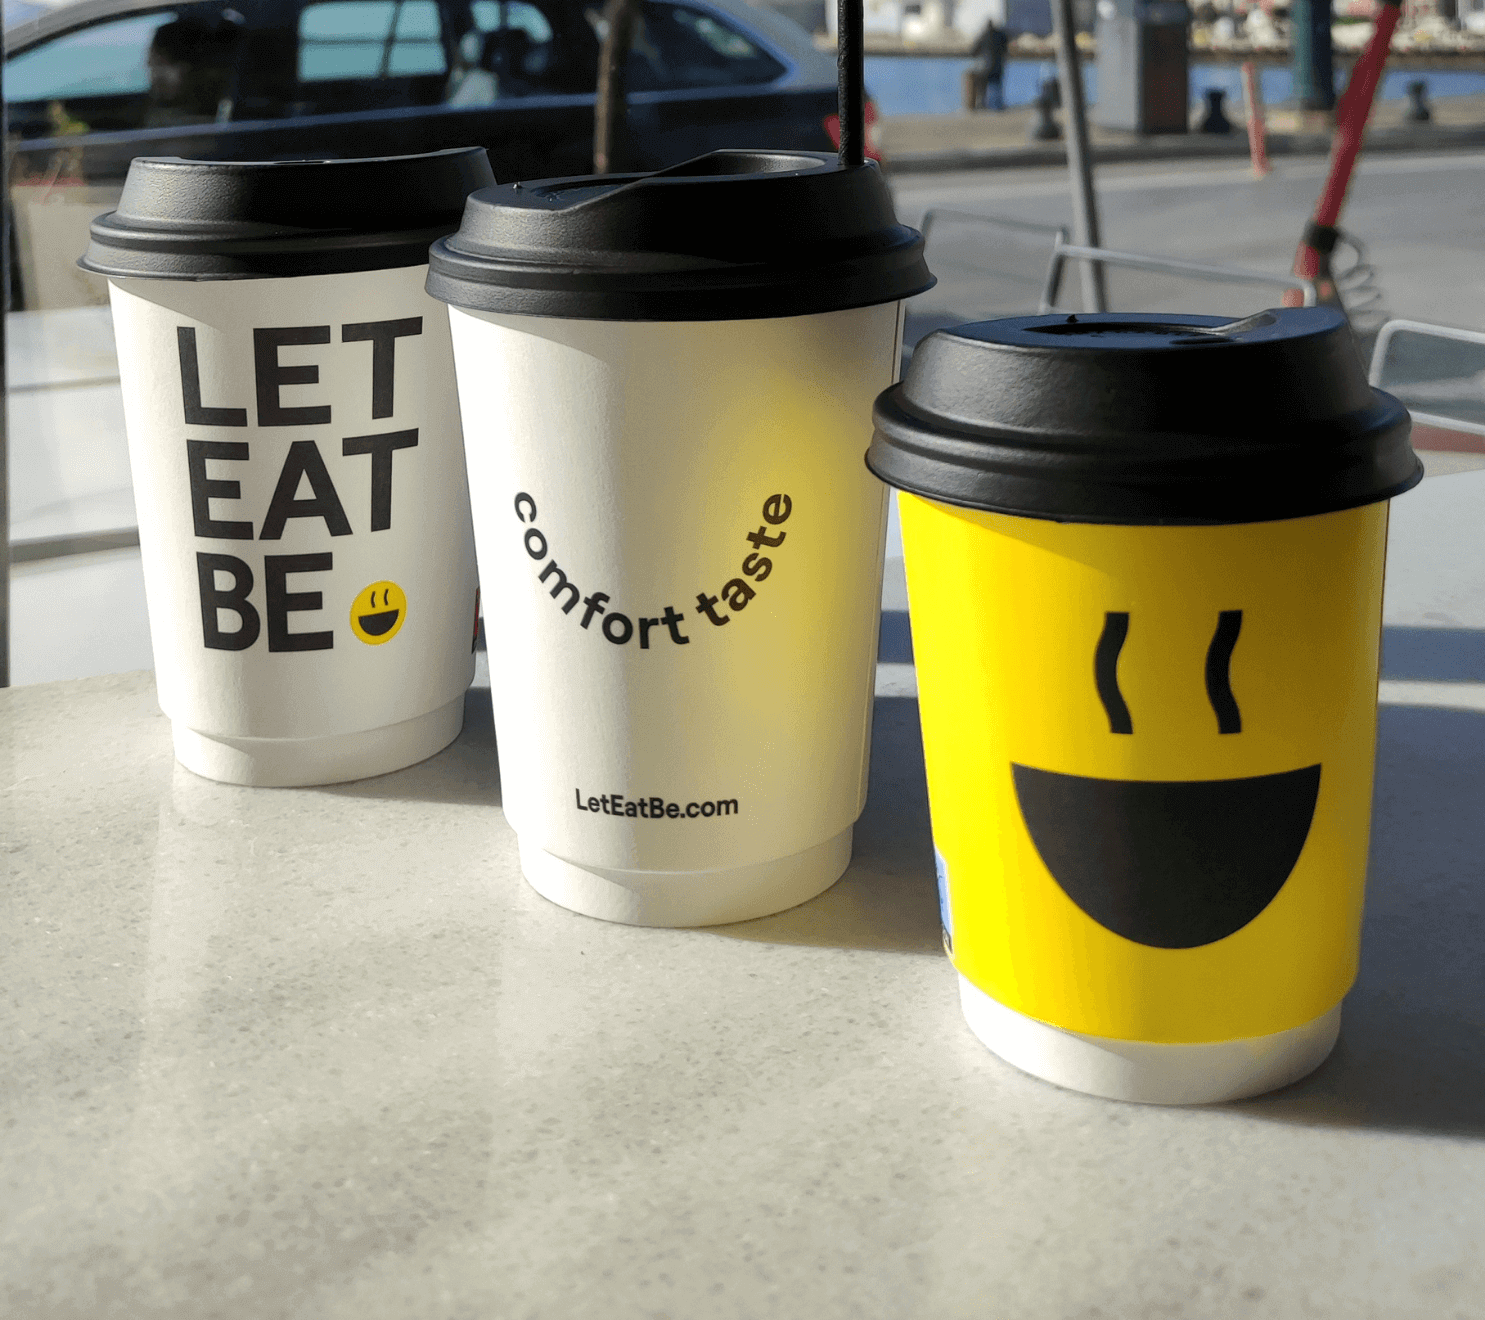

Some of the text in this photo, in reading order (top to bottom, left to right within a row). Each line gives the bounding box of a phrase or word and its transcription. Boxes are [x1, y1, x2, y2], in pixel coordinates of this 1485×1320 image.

[176, 315, 424, 428] LET
[186, 427, 420, 542] EAT
[195, 550, 335, 654] BE
[513, 490, 793, 651] comfort taste
[573, 787, 740, 821] LetEatBe.com
